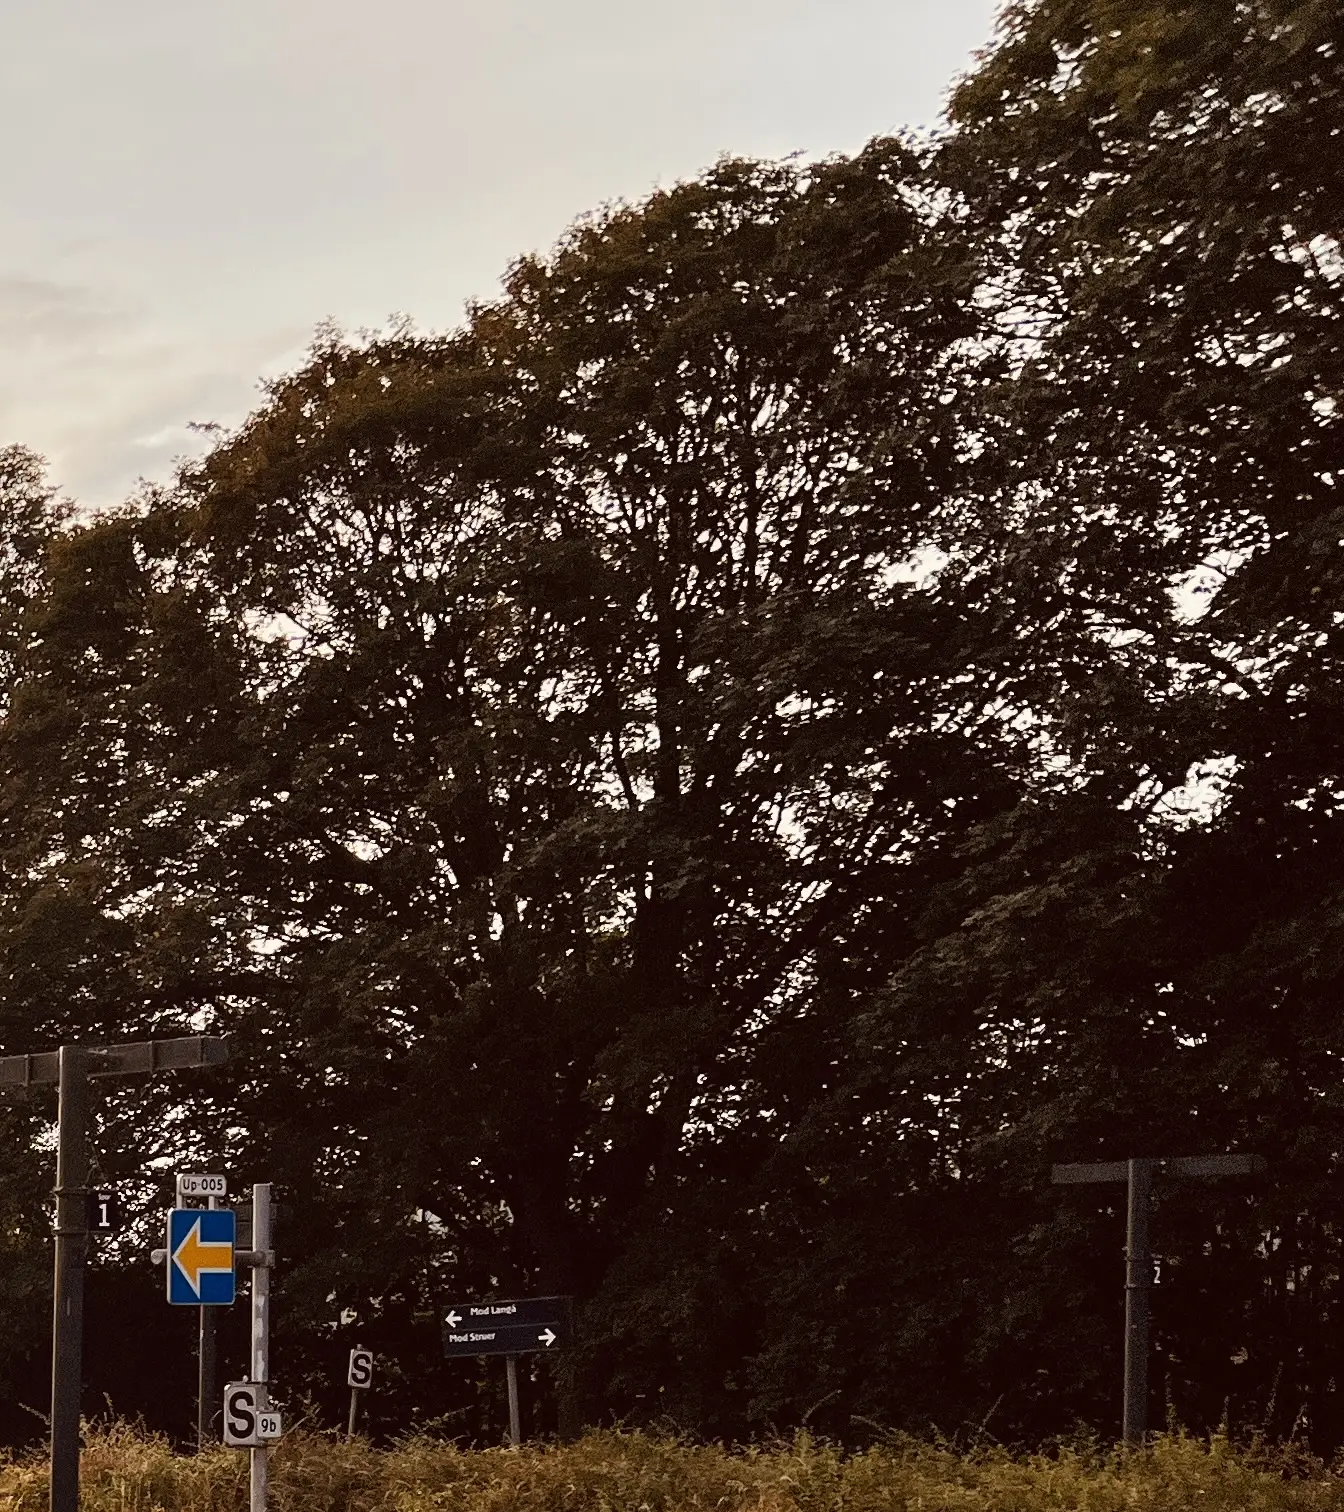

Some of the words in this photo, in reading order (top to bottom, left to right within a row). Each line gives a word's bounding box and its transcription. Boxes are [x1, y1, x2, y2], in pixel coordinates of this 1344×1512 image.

[98, 1203, 111, 1227] 1
[470, 1306, 490, 1316] Mod
[449, 1333, 469, 1343] Mod
[351, 1353, 371, 1384] S
[227, 1390, 255, 1439] S
[261, 1418, 277, 1433] 9b
